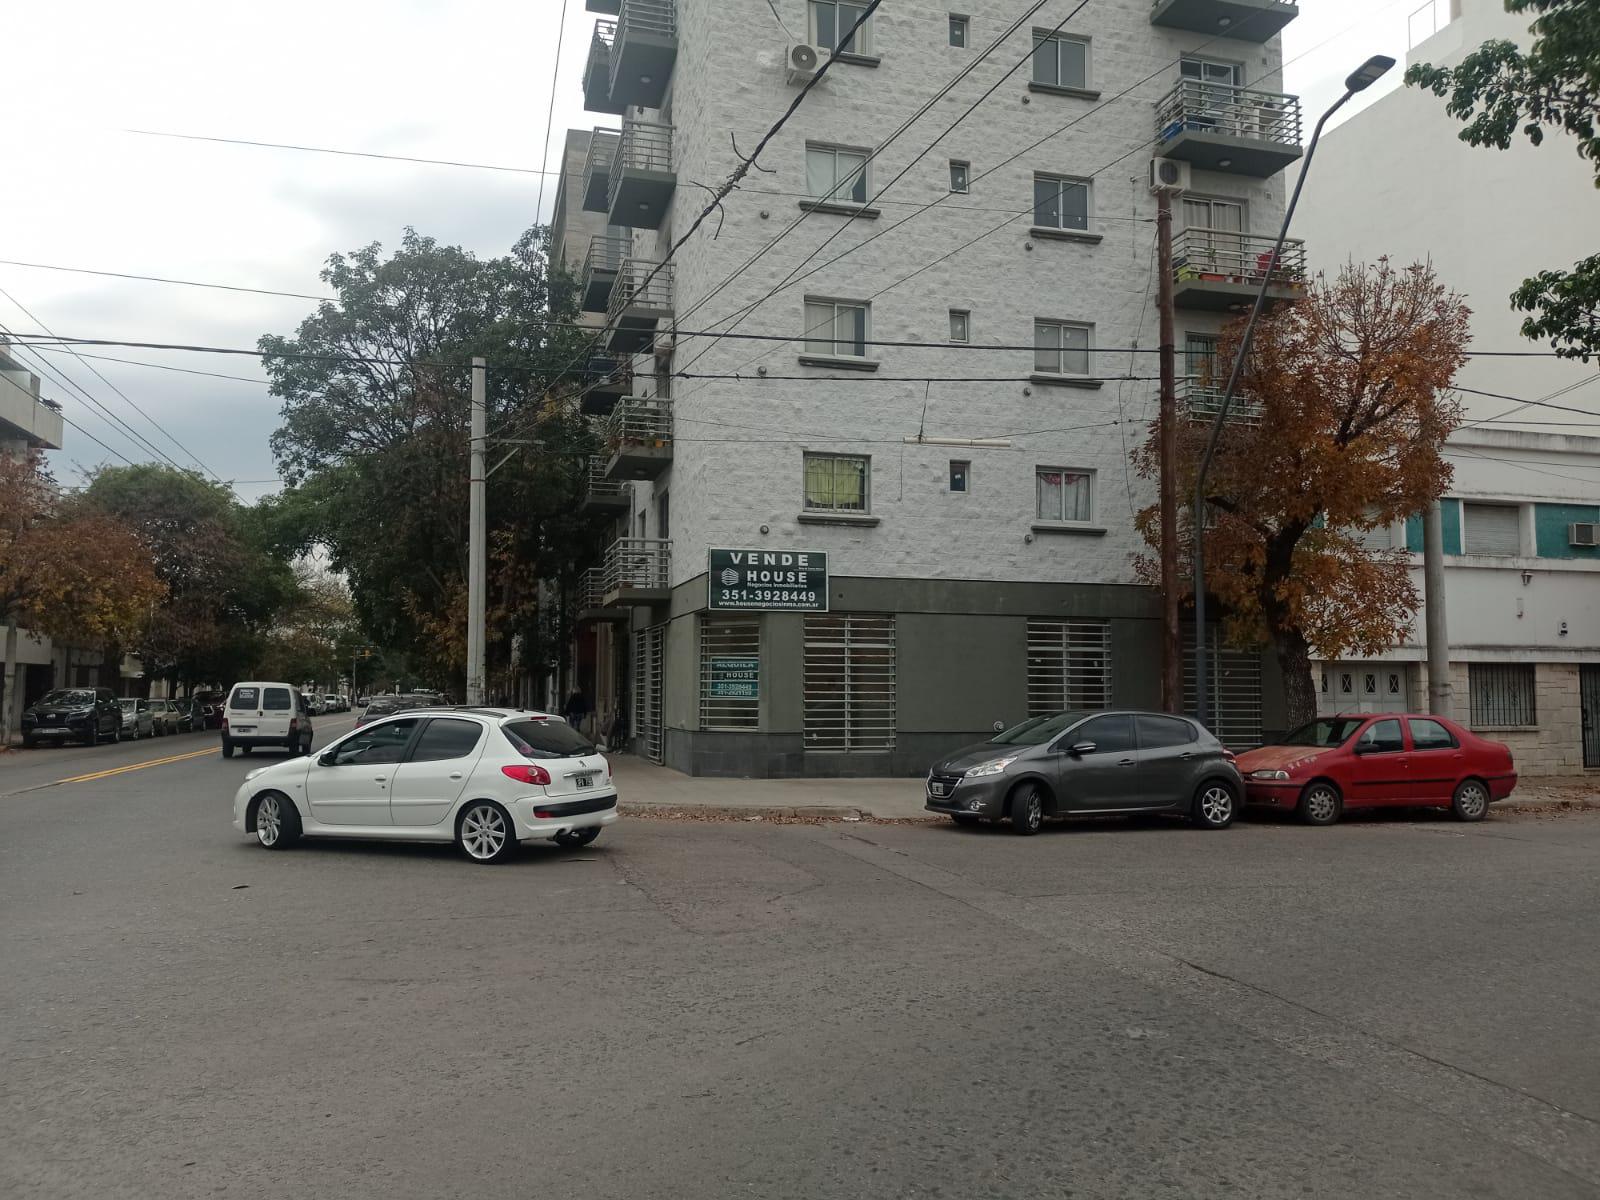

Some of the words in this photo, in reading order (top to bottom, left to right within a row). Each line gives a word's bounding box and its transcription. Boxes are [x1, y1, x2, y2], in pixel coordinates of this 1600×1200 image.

[730, 552, 809, 567] VENDE
[747, 570, 807, 583] HOUSE
[721, 589, 816, 602] 351-3928449
